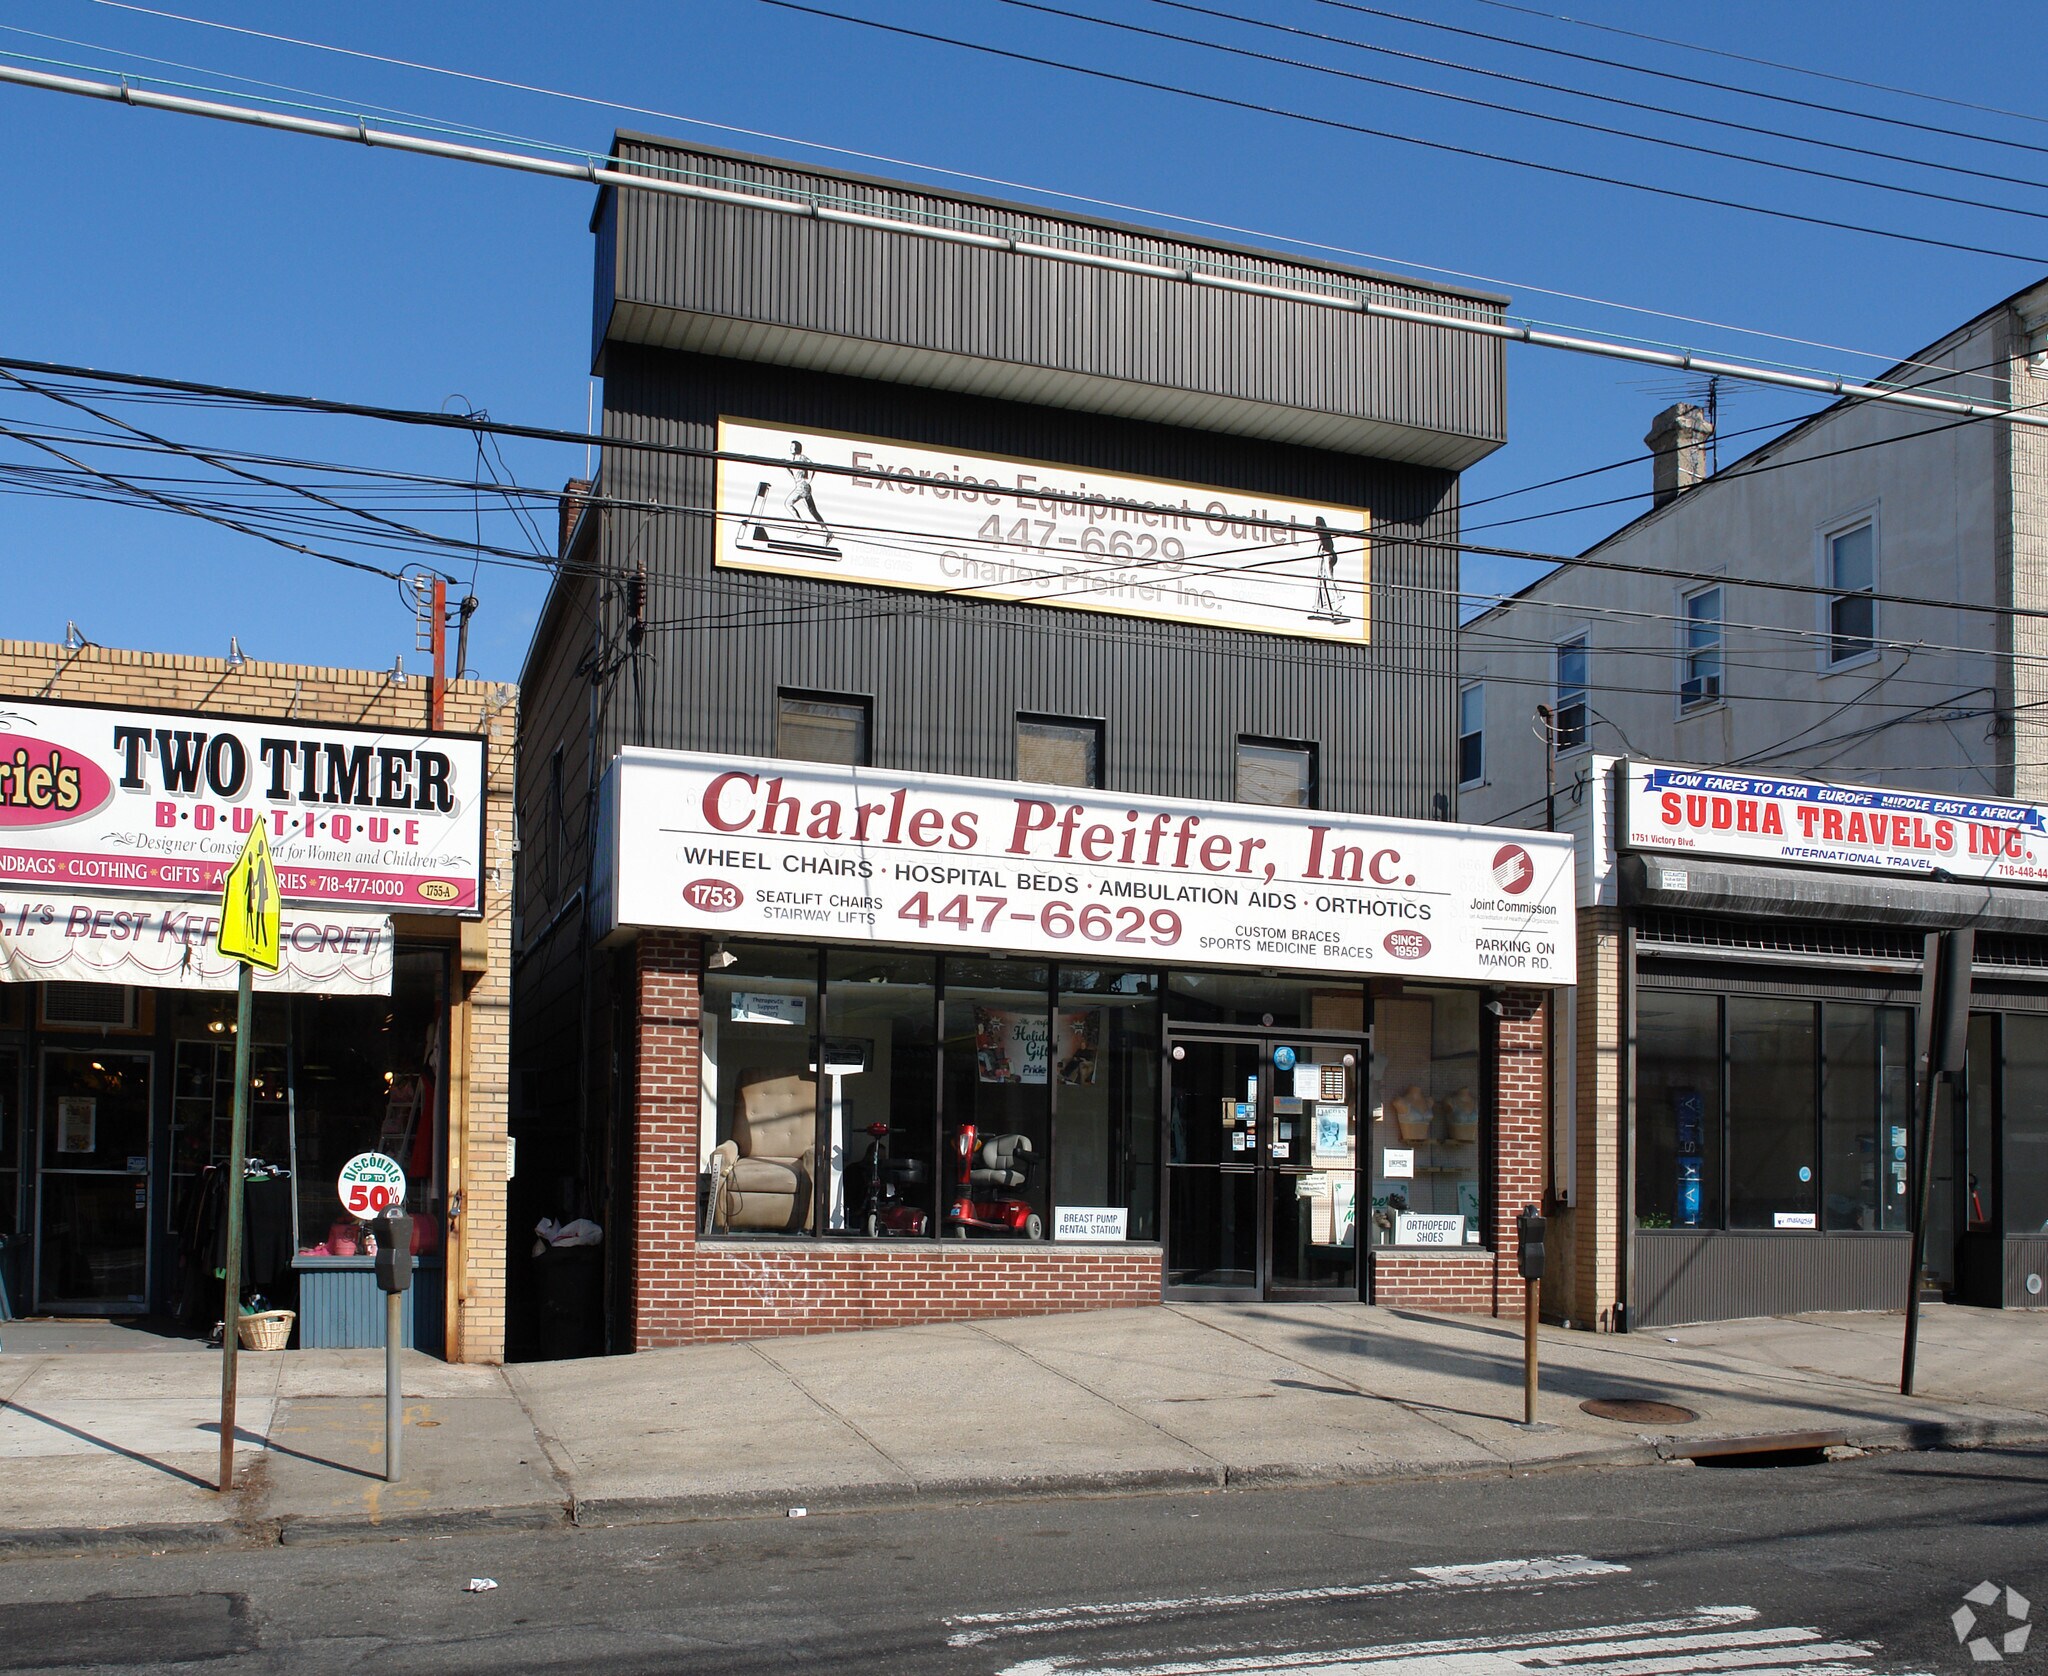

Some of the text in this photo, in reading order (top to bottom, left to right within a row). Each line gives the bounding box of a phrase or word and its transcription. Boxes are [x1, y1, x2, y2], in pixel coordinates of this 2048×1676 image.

[851, 451, 1300, 547] Exercise Equipment Outlet
[977, 514, 1186, 572] 447-6629
[940, 550, 1052, 591] Charles
[1061, 564, 1167, 604] Pfeiffer
[1175, 578, 1223, 611] Inc.
[113, 725, 456, 814] TWO TIMER
[1667, 772, 2027, 821] LOW FARES TO ASIA EUROPE MIDDLE EAST & AFRICA
[702, 771, 980, 851] Charles
[1005, 797, 1277, 886] Pfeiffer,
[1300, 825, 1417, 887] Inc.
[1661, 791, 2033, 860] SUDHA TRAVELS INC.
[136, 832, 197, 855] Designer
[284, 842, 308, 863] for
[307, 845, 352, 864] Women
[355, 849, 379, 865] and
[383, 849, 439, 868] Children
[1631, 832, 1697, 849] 1751 Victory Blvd.
[1781, 846, 1934, 869] INTERNATIONAL TRAVEL
[68, 859, 148, 880] CLOTHING
[159, 865, 200, 883] GIFTS
[318, 875, 404, 896] 718-477-1000
[684, 846, 1432, 922] WHEEL CHAIRS HOSPITAL BEDS AMBULATION AIDS ORTHOTICS
[426, 884, 451, 898] 1755-A
[689, 883, 738, 909] 1753
[756, 888, 884, 911] SEATLIFT CHAIRS
[763, 905, 877, 927] STAIRWAY LIFTS
[1469, 898, 1557, 916] Joint Commission
[64, 905, 153, 942] BEST
[157, 910, 221, 947] KEP
[898, 891, 1183, 947] 447-6629
[1235, 925, 1341, 944] CUSTOM BRACES
[1389, 933, 1424, 949] SINCE
[1475, 938, 1555, 954] PARKING ON
[1199, 936, 1374, 960] SPORTS MEDICINE BRACES
[1393, 945, 1421, 959] 1959
[1478, 953, 1552, 970] MANOR RD.
[1022, 1064, 1047, 1075] Pride
[1059, 1223, 1122, 1236] RENTAL STATION
[1063, 1212, 1119, 1225] BREAST PUMP
[1406, 1219, 1457, 1231] ORTHOPEDIC
[1416, 1231, 1444, 1243] SHOES
